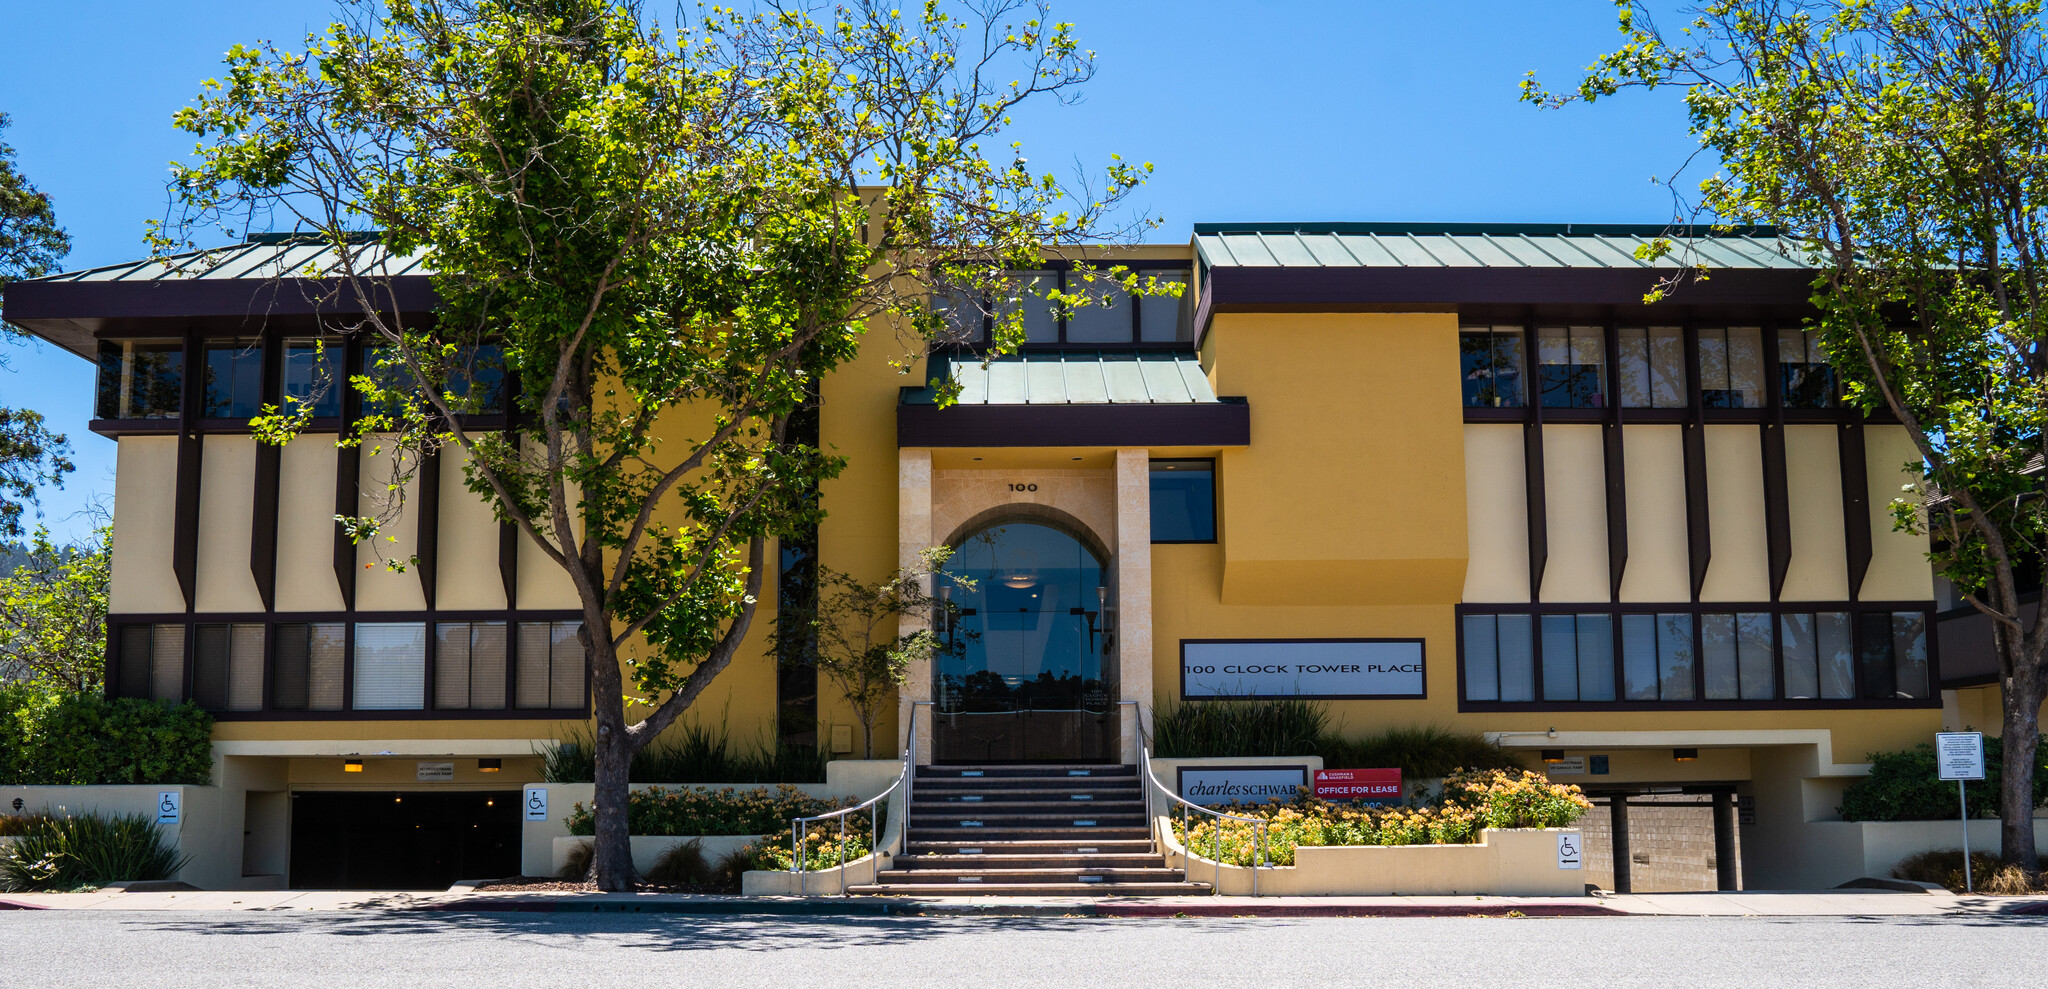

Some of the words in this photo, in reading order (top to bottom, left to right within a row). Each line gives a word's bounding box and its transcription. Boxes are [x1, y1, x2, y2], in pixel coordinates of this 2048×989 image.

[1008, 483, 1038, 492] 100
[1185, 665, 1215, 674] 100
[1223, 665, 1288, 674] CLOCK
[1295, 664, 1361, 673] TOWER
[1368, 664, 1424, 673] PLACE
[1189, 780, 1241, 796] charles
[1242, 785, 1297, 795] SCHWAB
[1317, 786, 1349, 794] OFFICE
[1351, 786, 1369, 794] FOR
[1371, 785, 1398, 793] LEASE
